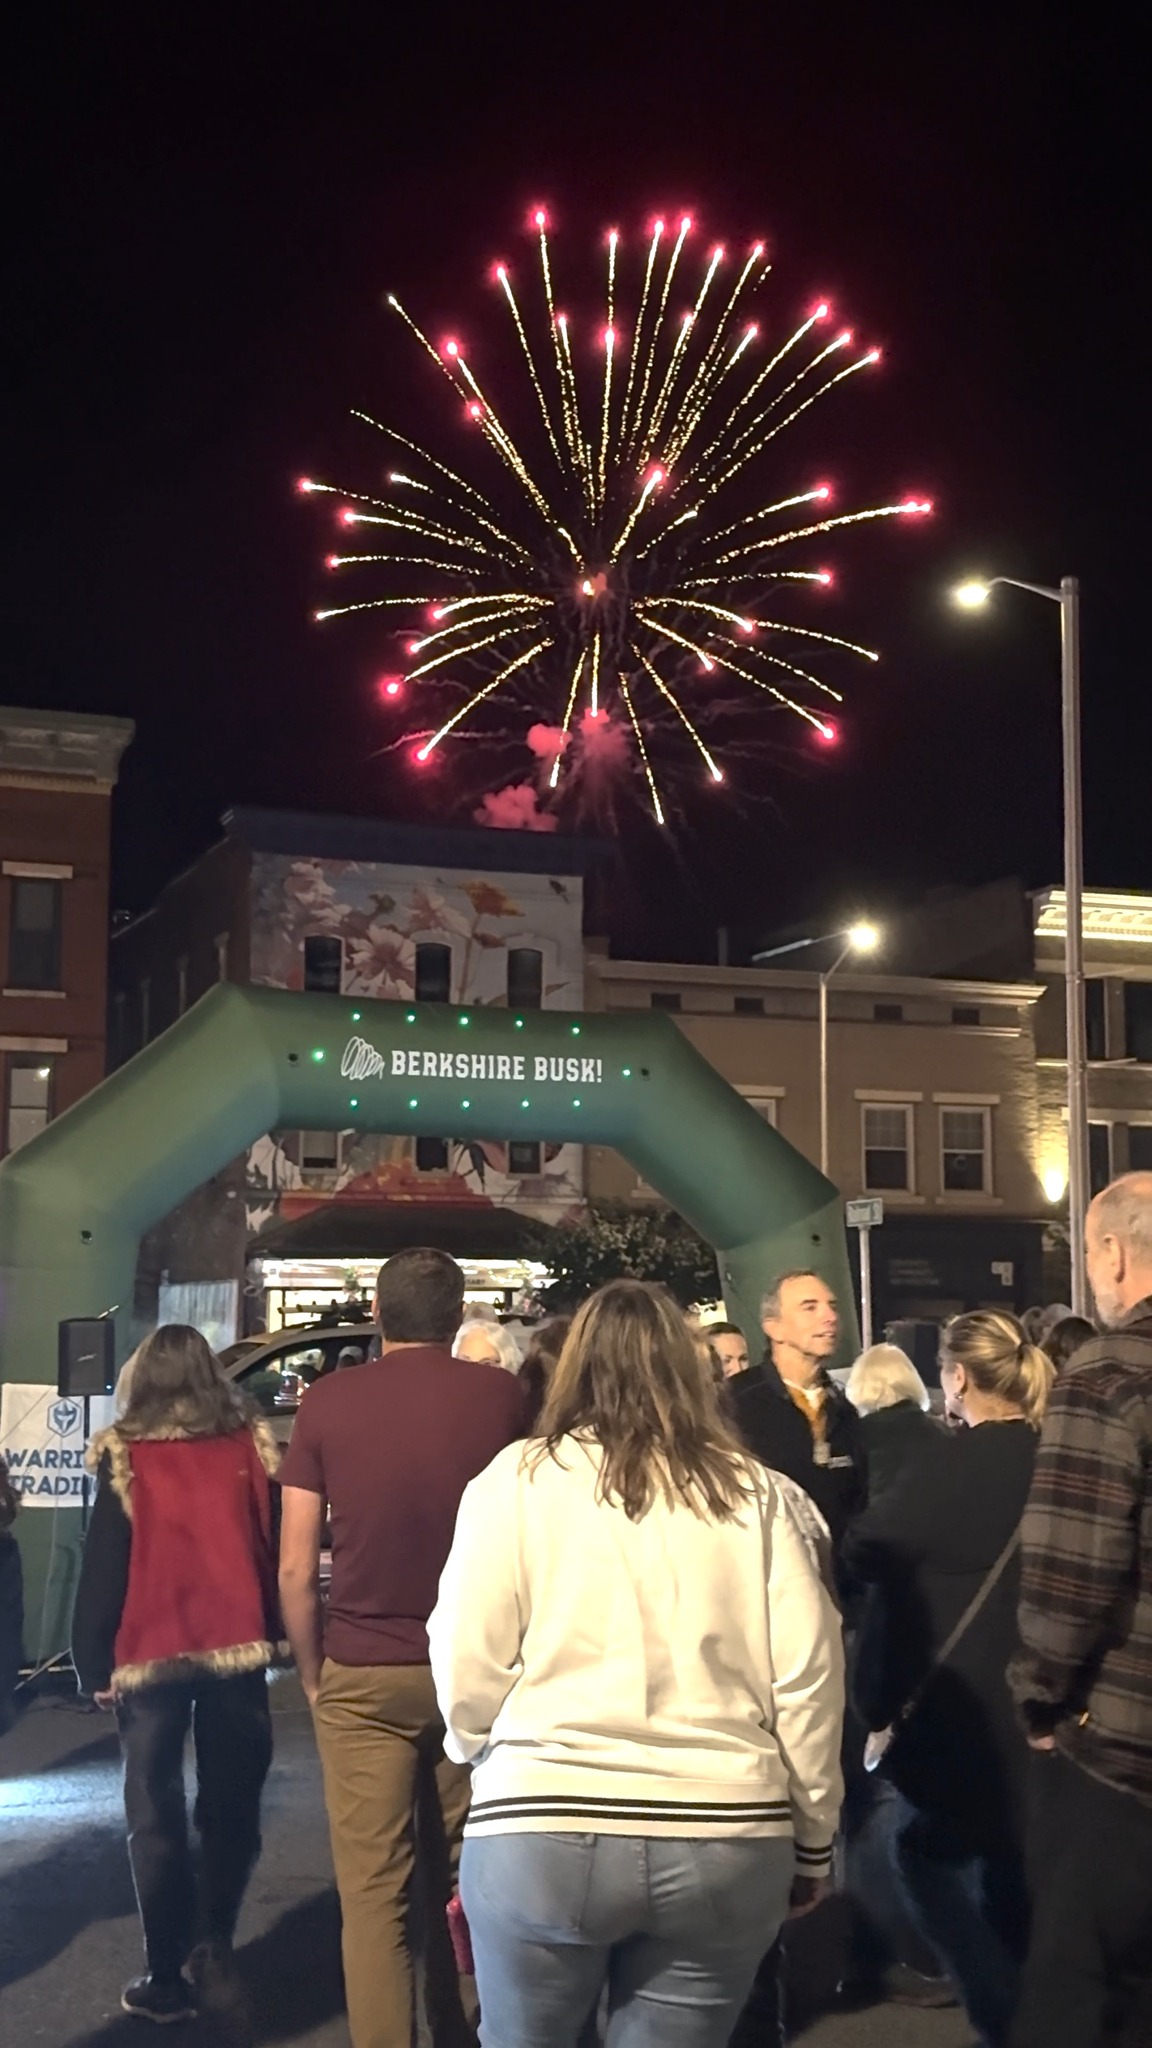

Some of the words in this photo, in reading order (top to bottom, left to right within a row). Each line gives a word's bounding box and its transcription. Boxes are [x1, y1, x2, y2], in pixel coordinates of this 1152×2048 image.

[391, 1050, 525, 1080] BERKSHIRE
[534, 1057, 603, 1083] BUSK!
[5, 1448, 86, 1468] WARRI
